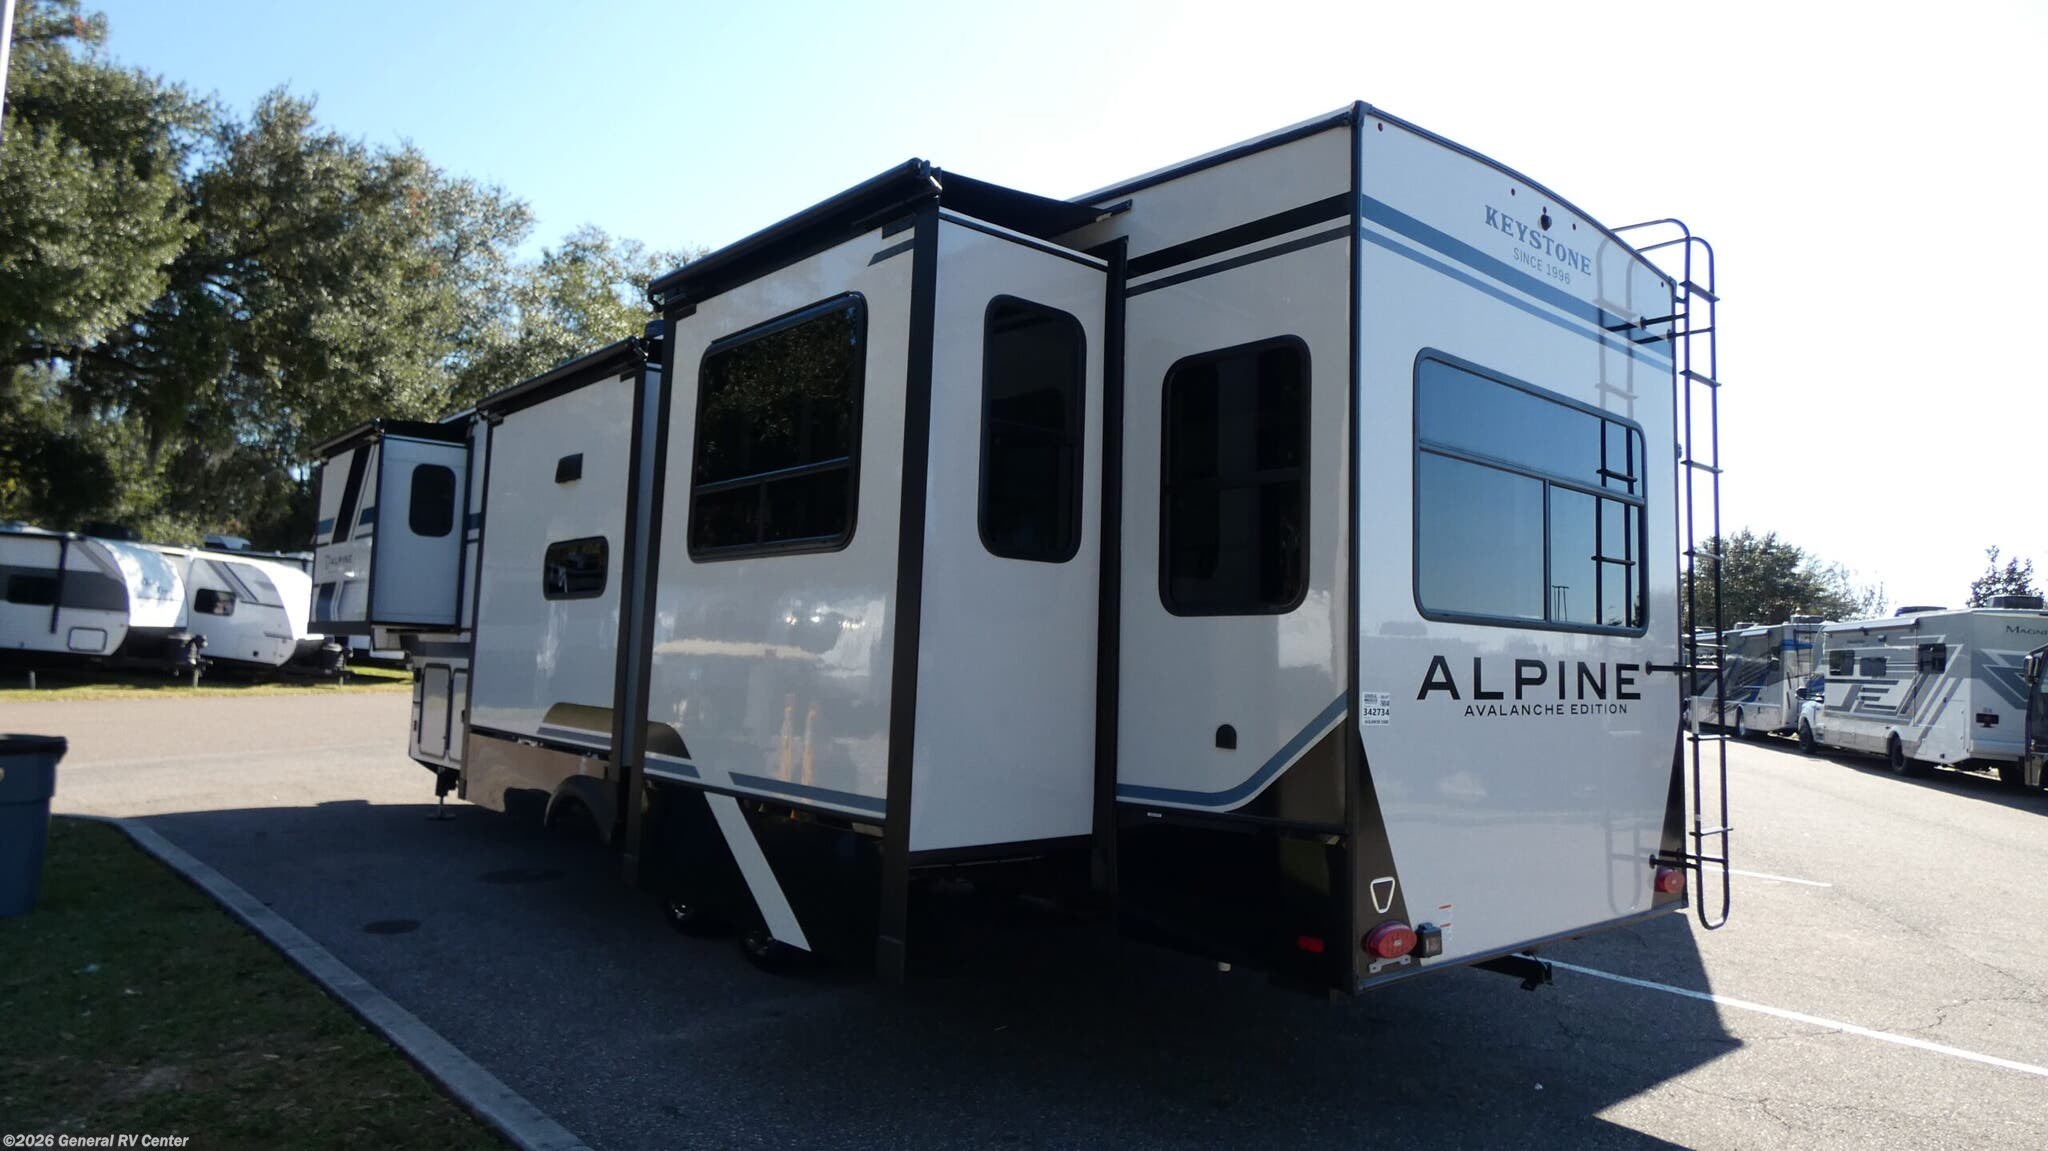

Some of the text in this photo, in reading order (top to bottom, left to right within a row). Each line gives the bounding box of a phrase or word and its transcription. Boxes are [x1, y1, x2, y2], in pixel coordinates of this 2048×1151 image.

[1485, 204, 1592, 276] KEYSTONE
[1514, 247, 1571, 285] SINCE 1996
[1416, 655, 1641, 700] ALPINE
[1363, 708, 1390, 716] 342734
[1464, 703, 1627, 717] AVALANCHE EDITION
